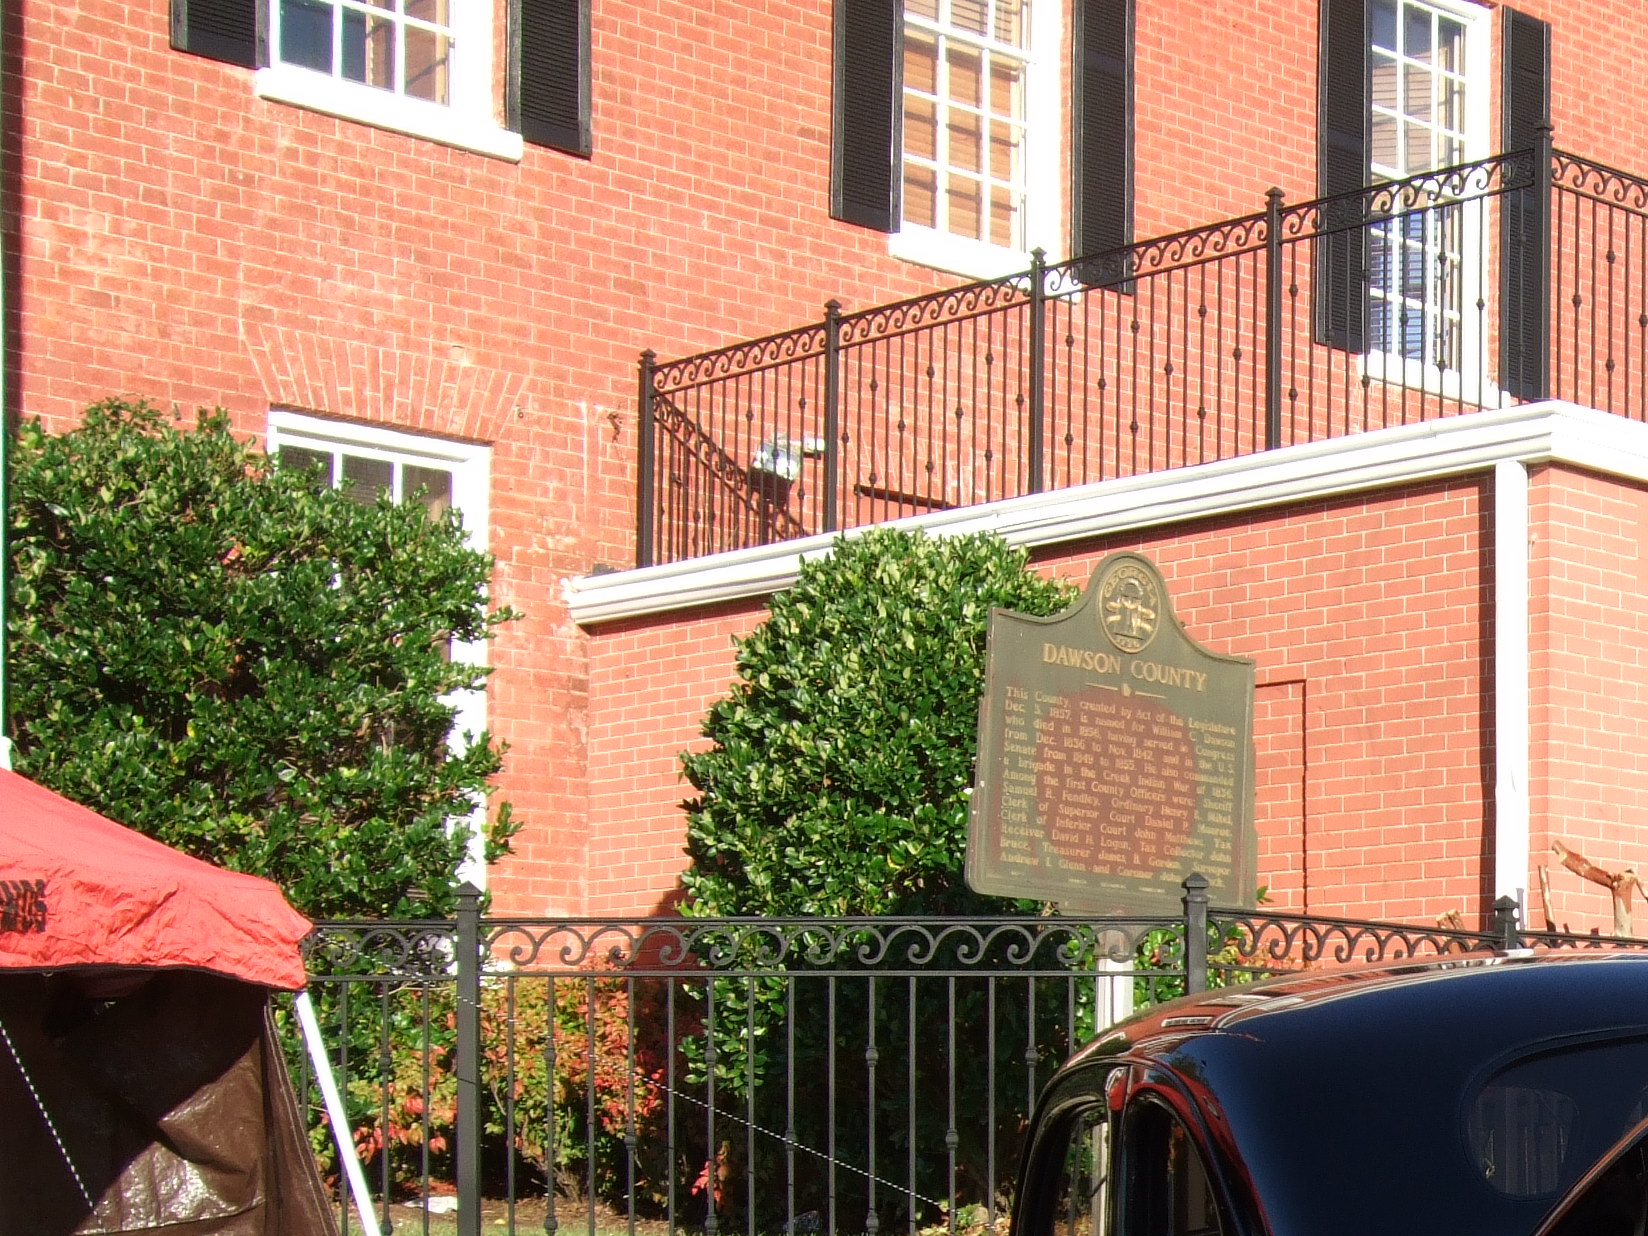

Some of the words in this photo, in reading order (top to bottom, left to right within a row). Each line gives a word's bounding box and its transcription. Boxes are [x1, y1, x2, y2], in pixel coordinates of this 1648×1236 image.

[1043, 643, 1121, 675] DAWSON
[1131, 660, 1207, 692] COUNTY
[1006, 686, 1028, 700] This
[1080, 701, 1115, 714] created
[1121, 707, 1132, 719] by
[1136, 709, 1151, 720] Act
[1156, 713, 1165, 722] of
[1170, 715, 1183, 726] the
[1189, 717, 1236, 735] Legislature
[1081, 713, 1088, 722] is
[1096, 717, 1125, 729] named
[1132, 722, 1145, 732] for
[1153, 725, 1182, 738] William
[1204, 734, 1235, 747] Dawson
[1005, 715, 1024, 726] who
[1033, 719, 1054, 731] died
[1063, 725, 1071, 733] in
[1108, 732, 1136, 747] having
[1144, 739, 1173, 751] served
[1180, 742, 1188, 752] in
[1196, 746, 1234, 761] Congress
[1005, 728, 1027, 740] from
[1092, 742, 1101, 752] to
[1163, 755, 1179, 764] and
[1185, 757, 1193, 767] in
[1199, 760, 1212, 770] the
[1004, 742, 1037, 755] Senate
[1044, 747, 1066, 760] from
[1100, 756, 1109, 766] to
[1144, 763, 1157, 774] He
[1162, 767, 1178, 777] also
[1184, 771, 1234, 786] commanded
[1018, 757, 1055, 772] brigade
[1064, 764, 1073, 775] in
[1081, 767, 1096, 778] the
[1103, 770, 1130, 783] Creek
[1138, 776, 1165, 789] Indian
[1174, 781, 1190, 792] War
[1196, 785, 1206, 795] of
[1003, 769, 1036, 785] Among
[1043, 775, 1059, 786] the
[1066, 777, 1086, 790] first
[1091, 781, 1124, 797] County
[1130, 787, 1166, 801] Officers
[1203, 799, 1233, 812] Sheriff
[1003, 782, 1037, 796] Samuel
[1111, 798, 1154, 815] Ordinary
[1162, 805, 1188, 819] Henry
[1001, 796, 1028, 808] Clerk
[1039, 802, 1049, 812] of
[1058, 804, 1099, 818] Superior
[1110, 811, 1135, 823] Court
[1145, 816, 1174, 829] Daniel
[1001, 810, 1027, 823] Clerk
[1036, 815, 1047, 825] of
[1056, 817, 1092, 831] Inferior
[1100, 823, 1127, 836] Court
[1135, 829, 1156, 839] John
[1214, 838, 1232, 849] Tax
[1001, 823, 1044, 838] Receiver
[1052, 830, 1079, 843] David
[1101, 838, 1131, 851] Logan,
[1140, 841, 1156, 853] Tax
[1164, 845, 1204, 859] Collector
[1210, 851, 1231, 863] John
[1042, 842, 1091, 858] Treasurer
[1192, 862, 1231, 876] Surveyor
[1000, 852, 1039, 865] Andrew
[1093, 864, 1110, 874] and
[1117, 866, 1154, 879] Coroner
